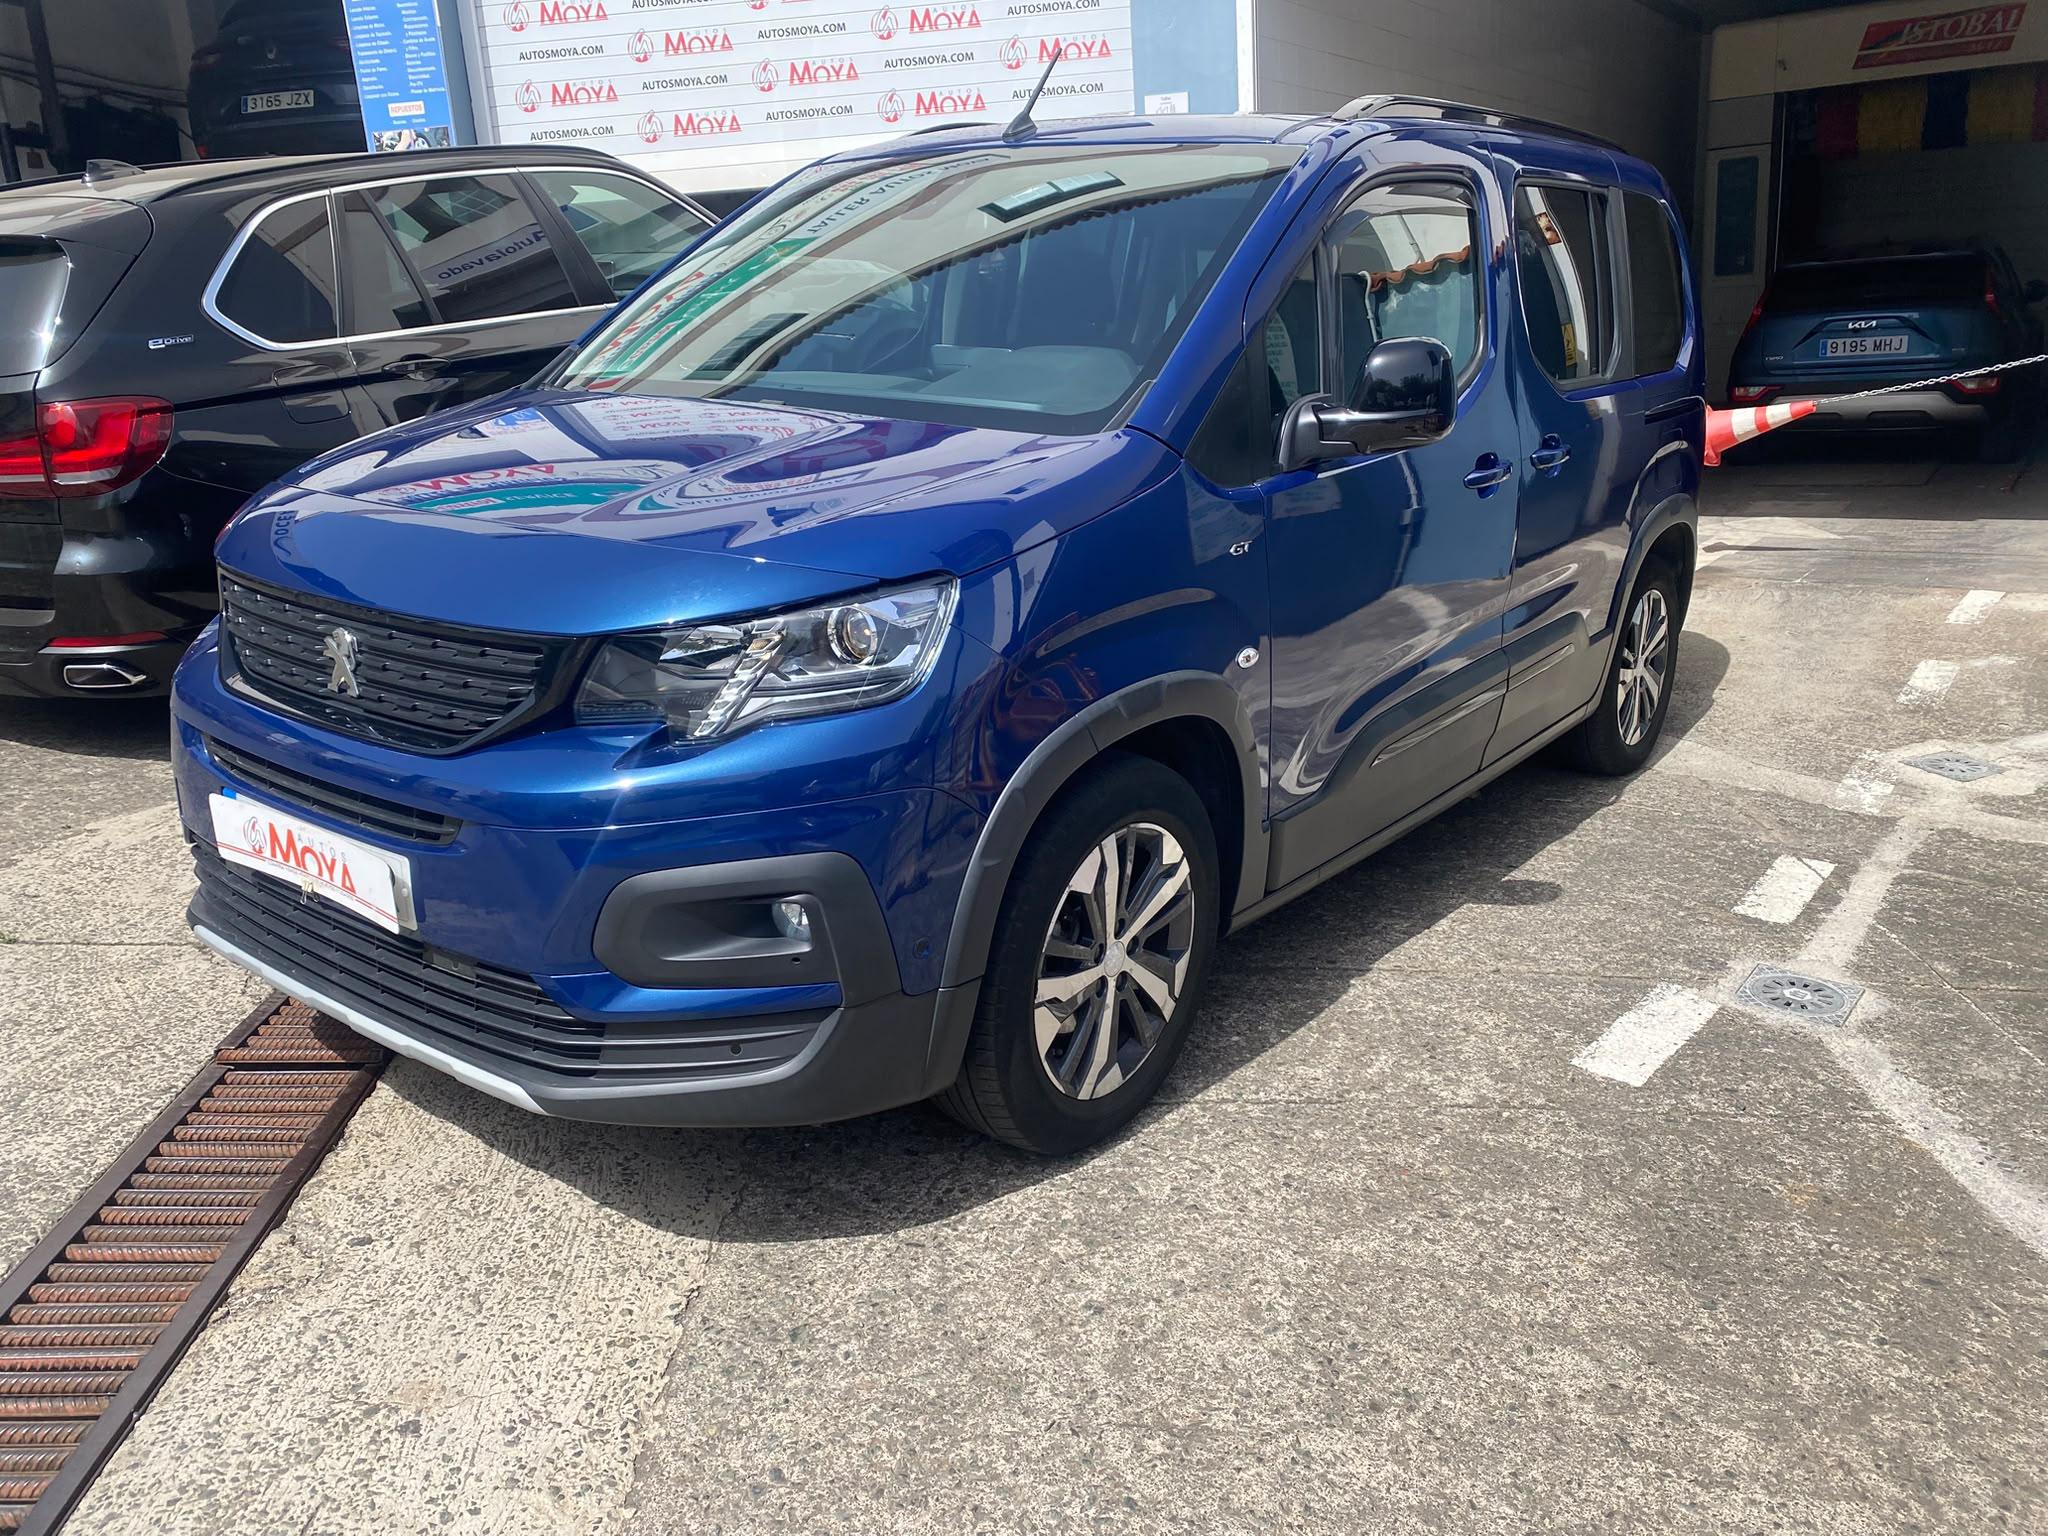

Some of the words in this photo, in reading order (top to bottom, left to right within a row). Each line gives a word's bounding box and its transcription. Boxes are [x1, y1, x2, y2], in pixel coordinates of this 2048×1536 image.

[540, 1, 608, 25] MOYA
[1007, 0, 1100, 15] AUTOSMOYA.COM
[909, 8, 982, 33] MOYA
[1903, 8, 2022, 44] ISTOBAL
[757, 23, 846, 39] AUTOSMOYA.COM
[519, 45, 604, 61] AUTOSMOYA.COM
[664, 31, 734, 56] MOYA
[1038, 37, 1112, 62] MOYA
[884, 52, 974, 68] AUTOSMOYA.COM
[789, 61, 860, 85] MOYA
[642, 75, 728, 91] AUTOSMOYA.COM
[1012, 82, 1104, 99] AUTSMOYA.COM
[249, 94, 282, 110] 3165
[286, 91, 311, 106] JZX
[552, 83, 619, 106] MOYA
[915, 91, 987, 115] MOYA
[766, 104, 853, 121] AUTOSMOYA.COM
[530, 126, 614, 141] AUTOSMOYA.COM
[674, 113, 742, 136] MOYA
[1830, 340, 1868, 353] 9195
[1873, 338, 1903, 351] MHJ
[1230, 540, 1253, 555] GT
[269, 822, 357, 894] MOYA
